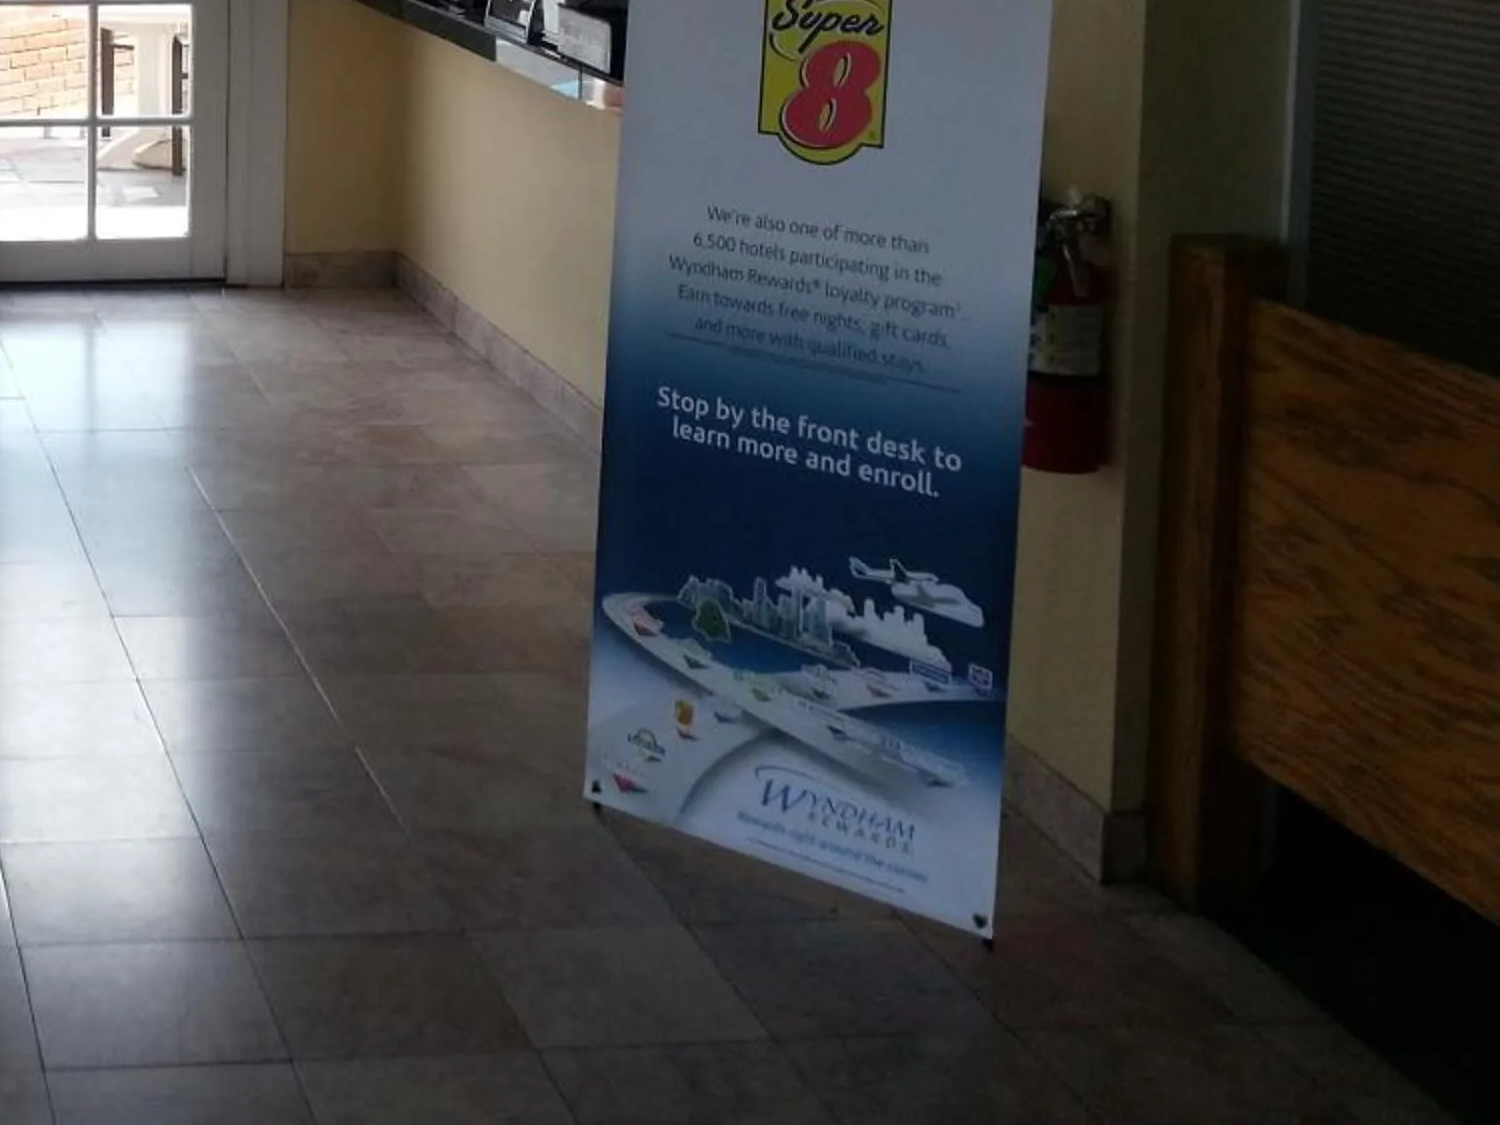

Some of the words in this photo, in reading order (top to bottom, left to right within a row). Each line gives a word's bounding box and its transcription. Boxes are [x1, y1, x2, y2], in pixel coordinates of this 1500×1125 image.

[780, 40, 881, 149] 8
[707, 204, 751, 226] We're
[755, 215, 785, 233] also
[789, 221, 819, 238] one
[823, 224, 840, 242] of
[843, 229, 887, 249] more
[891, 234, 930, 254] than
[669, 254, 743, 281] Wyndham
[825, 282, 880, 310] loyalty
[739, 239, 785, 261] hotels
[789, 249, 890, 283] participating
[894, 264, 909, 280] in
[914, 268, 942, 286] the
[678, 283, 710, 303] Earn
[713, 291, 775, 316] towards
[779, 301, 811, 322] free
[695, 317, 722, 334] and
[725, 324, 765, 343] more
[769, 332, 804, 350] with
[657, 386, 709, 419] Stop
[716, 397, 744, 429] by
[751, 406, 790, 435] the
[798, 414, 859, 451] front
[867, 431, 926, 465] desk
[934, 445, 962, 472] to
[672, 415, 730, 449] learn
[737, 435, 798, 465] more
[805, 454, 850, 477] and
[858, 462, 940, 499] enroll.
[761, 779, 915, 841] WYNDHAM
